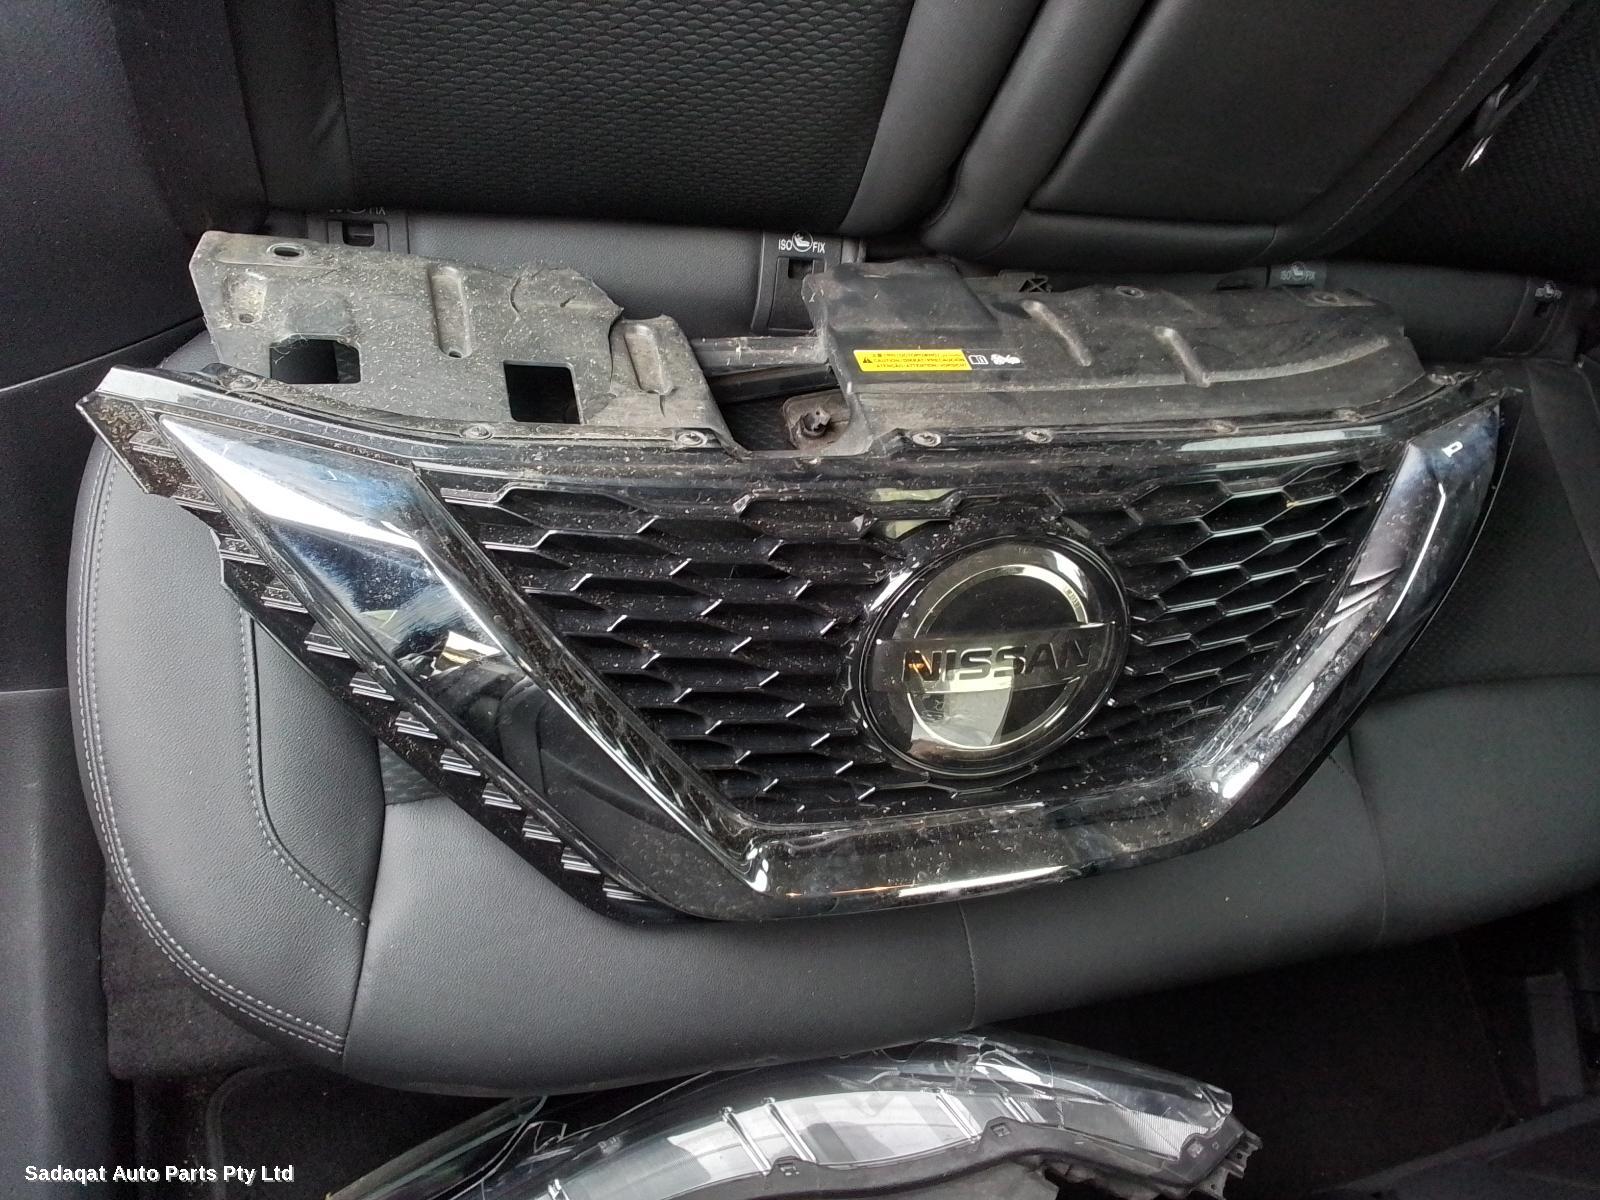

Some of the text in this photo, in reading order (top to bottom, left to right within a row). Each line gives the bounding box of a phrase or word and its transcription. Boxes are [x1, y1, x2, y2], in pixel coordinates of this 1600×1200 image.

[778, 239, 826, 254] ISO FIX
[902, 639, 1091, 682] NISSAN
